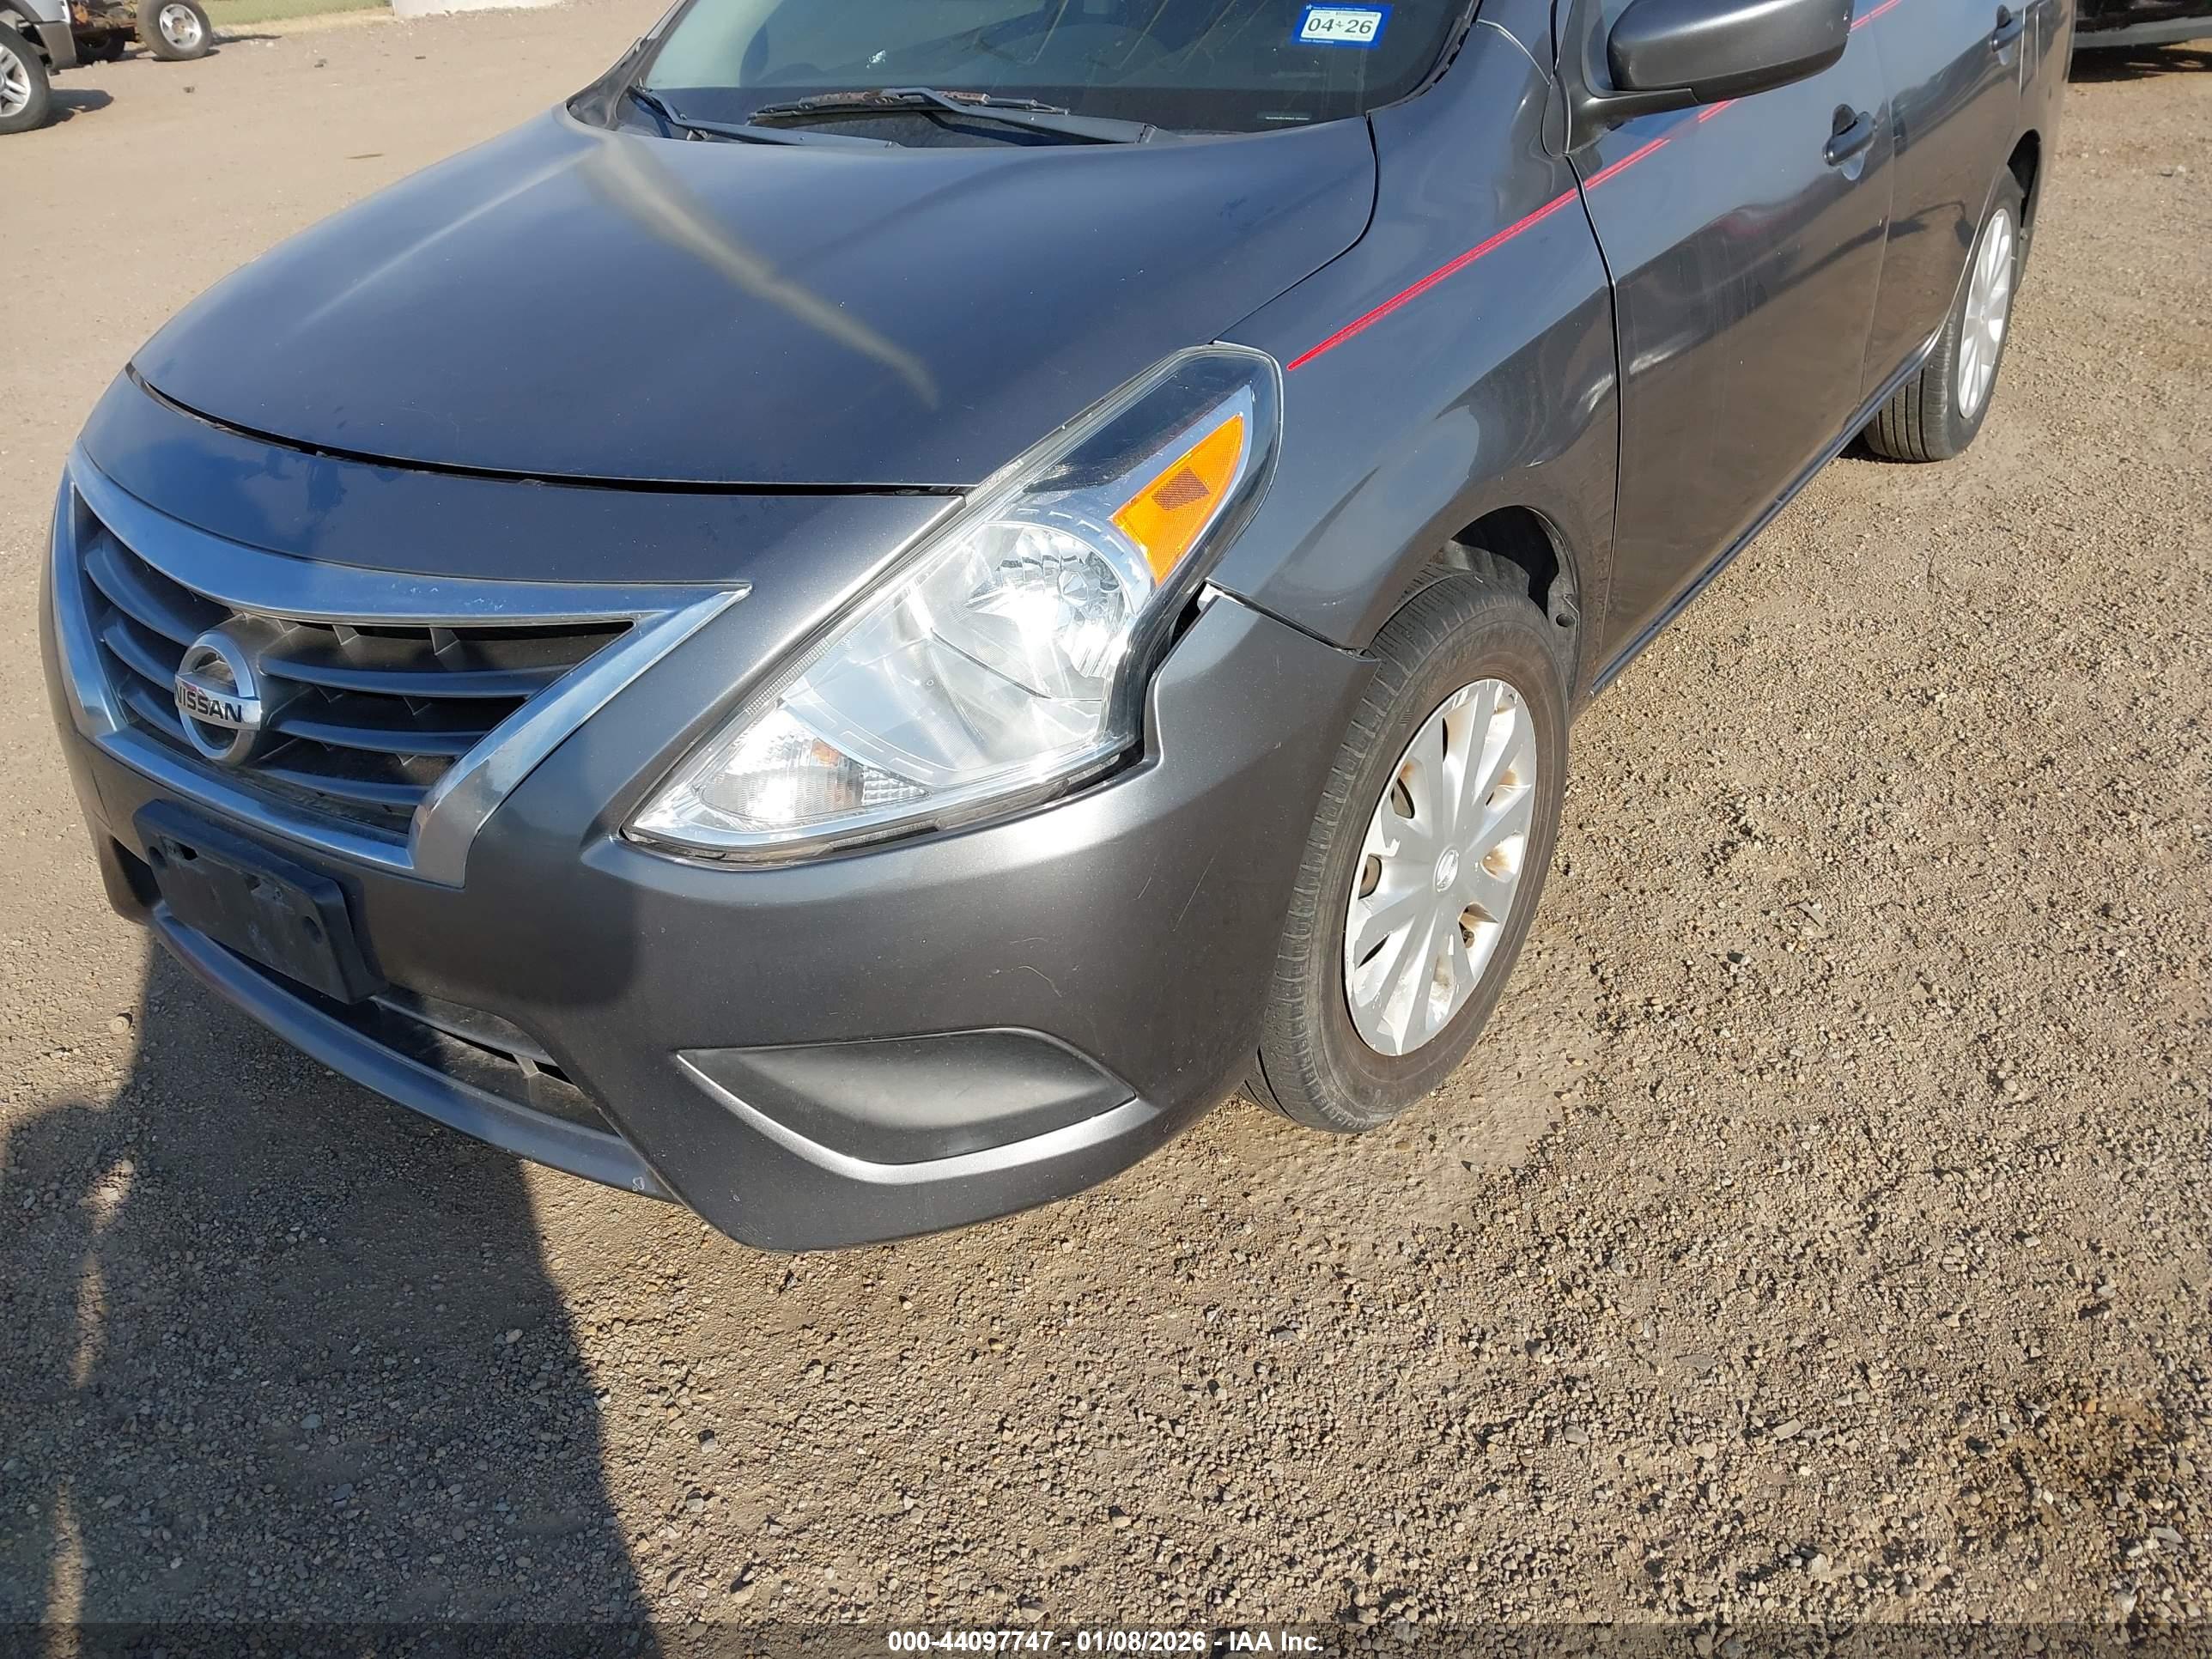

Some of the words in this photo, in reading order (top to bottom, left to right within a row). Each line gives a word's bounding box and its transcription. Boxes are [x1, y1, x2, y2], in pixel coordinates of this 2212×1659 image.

[1308, 17, 1334, 32] 04
[1344, 19, 1374, 33] 26
[174, 684, 242, 723] NISSAN
